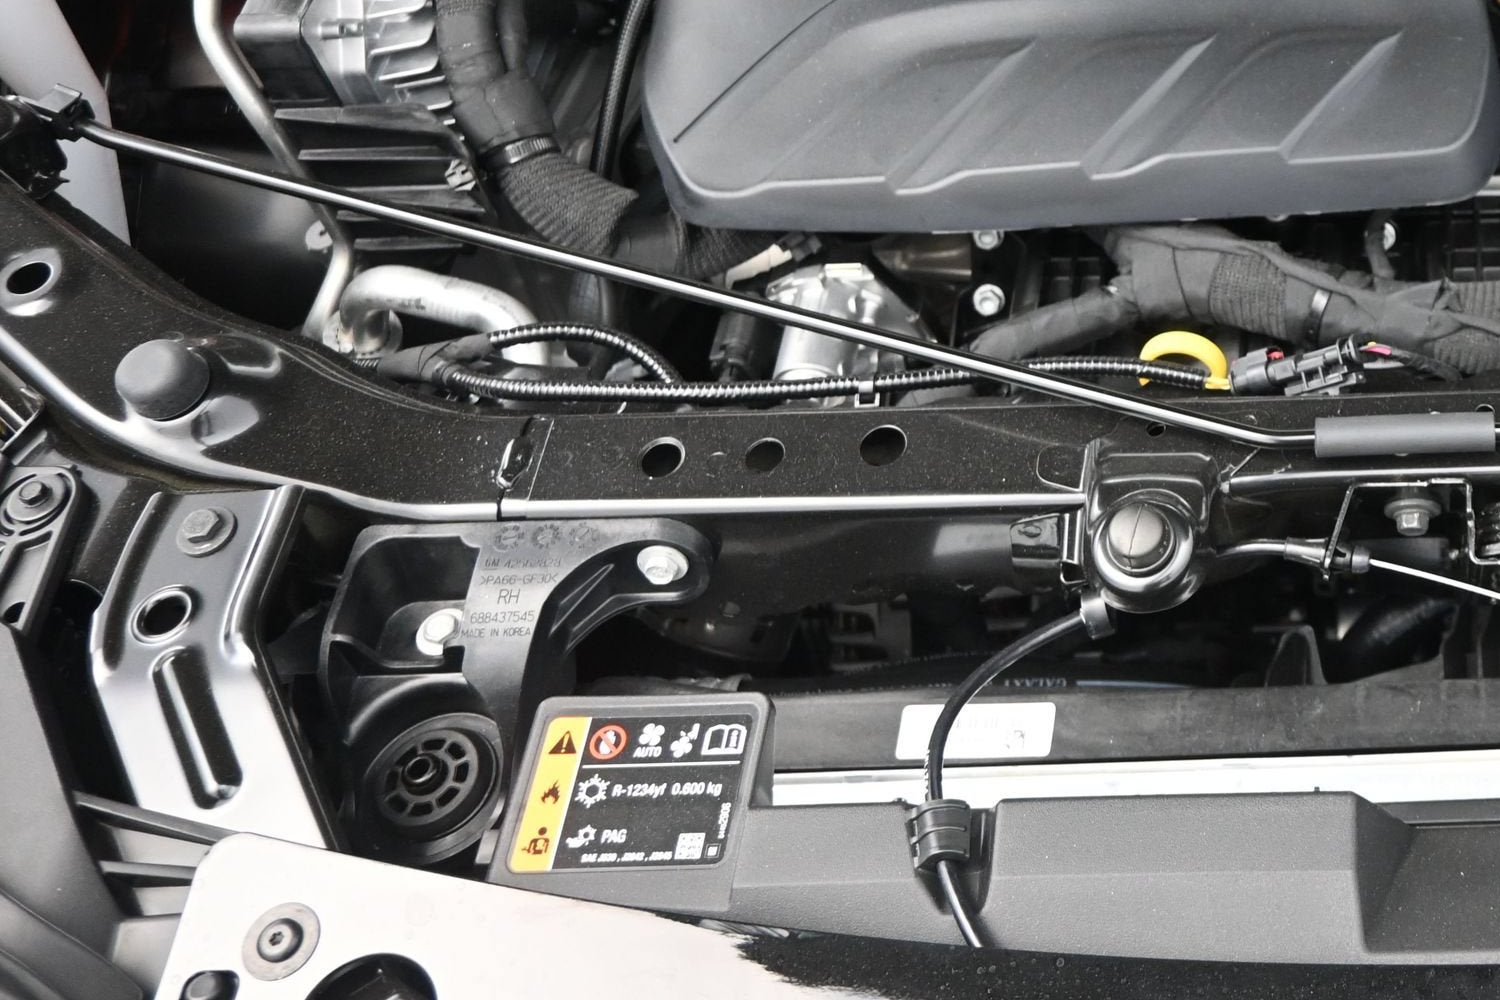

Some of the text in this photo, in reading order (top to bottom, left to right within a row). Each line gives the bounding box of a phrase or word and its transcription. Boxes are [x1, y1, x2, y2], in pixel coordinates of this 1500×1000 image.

[497, 588, 521, 605] RH
[470, 610, 535, 624] 688437545
[461, 626, 531, 638] MADE IN KOREA
[633, 746, 662, 758] AUTO
[611, 781, 723, 799] R-1234yf 0.600 kg
[601, 828, 628, 844] PAG
